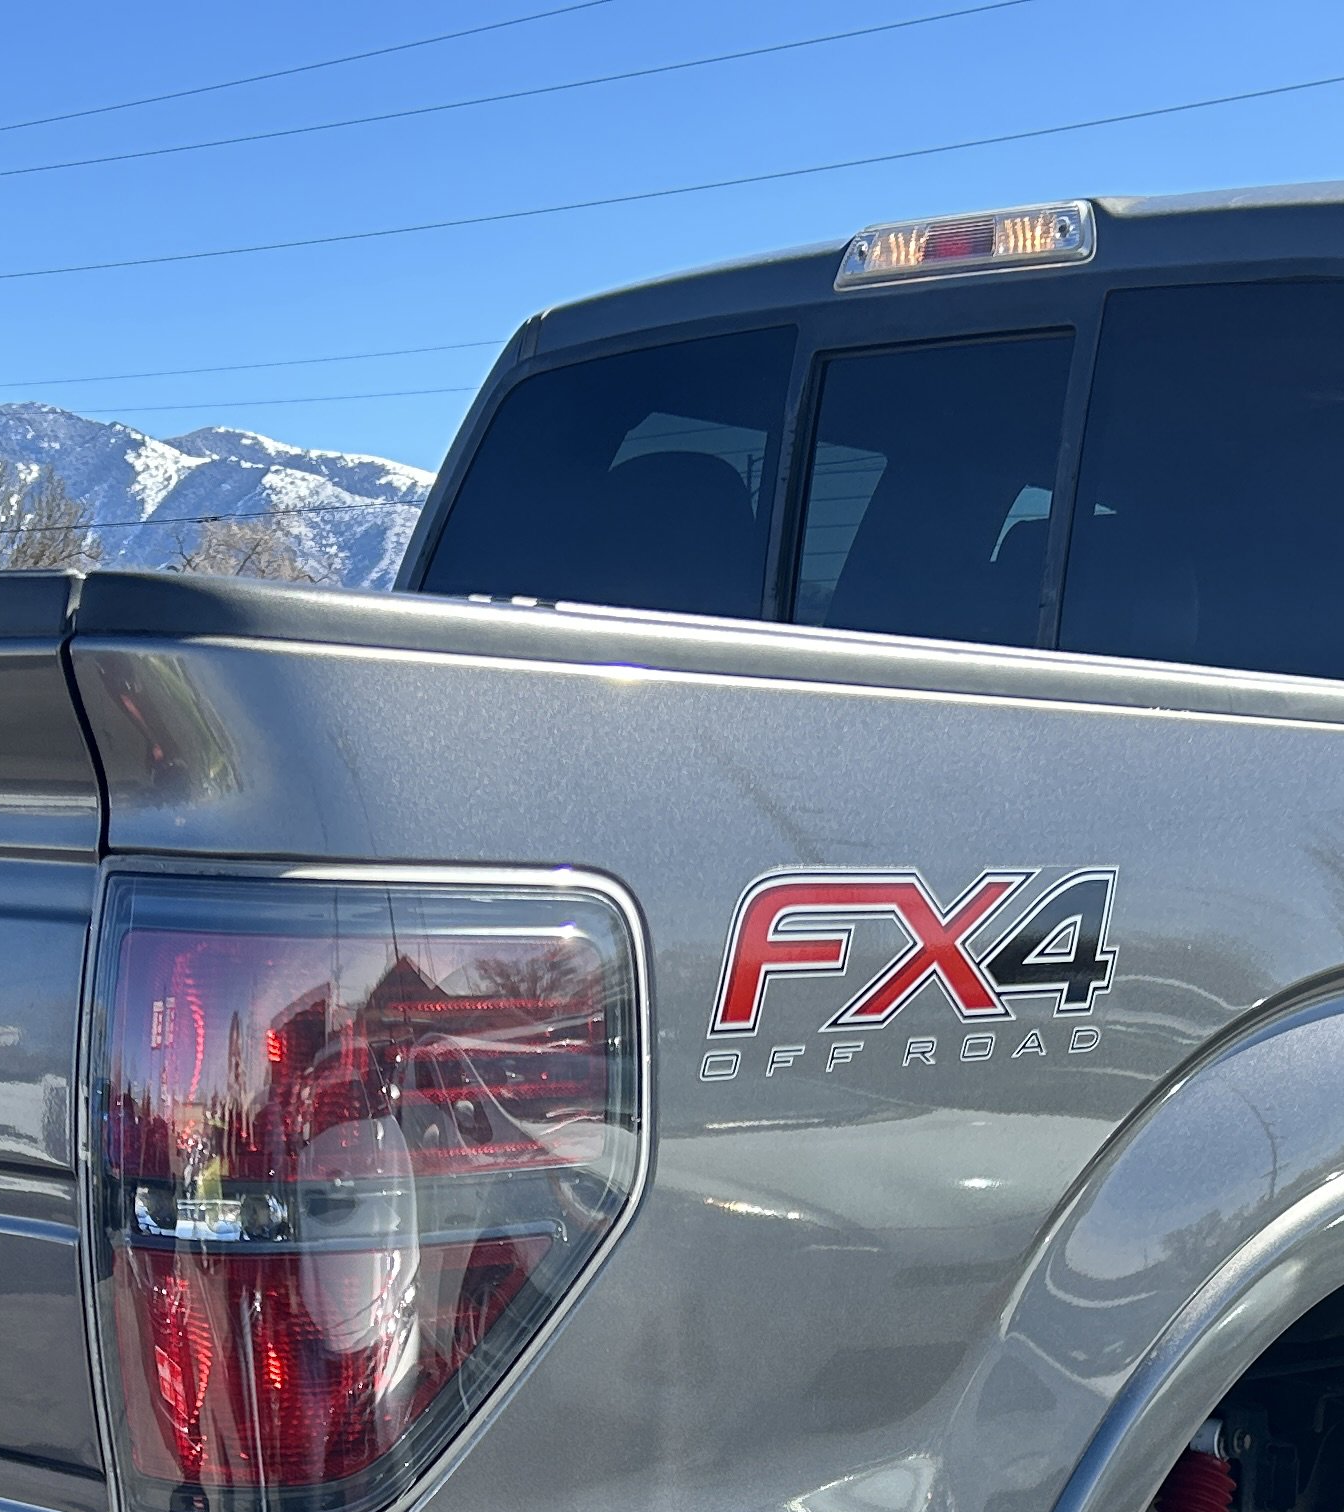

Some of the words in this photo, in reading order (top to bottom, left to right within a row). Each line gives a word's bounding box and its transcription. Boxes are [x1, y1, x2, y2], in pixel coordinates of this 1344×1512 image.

[706, 866, 1120, 1040] FX4
[699, 1041, 865, 1082] OFF
[901, 1025, 1102, 1068] ROAD
